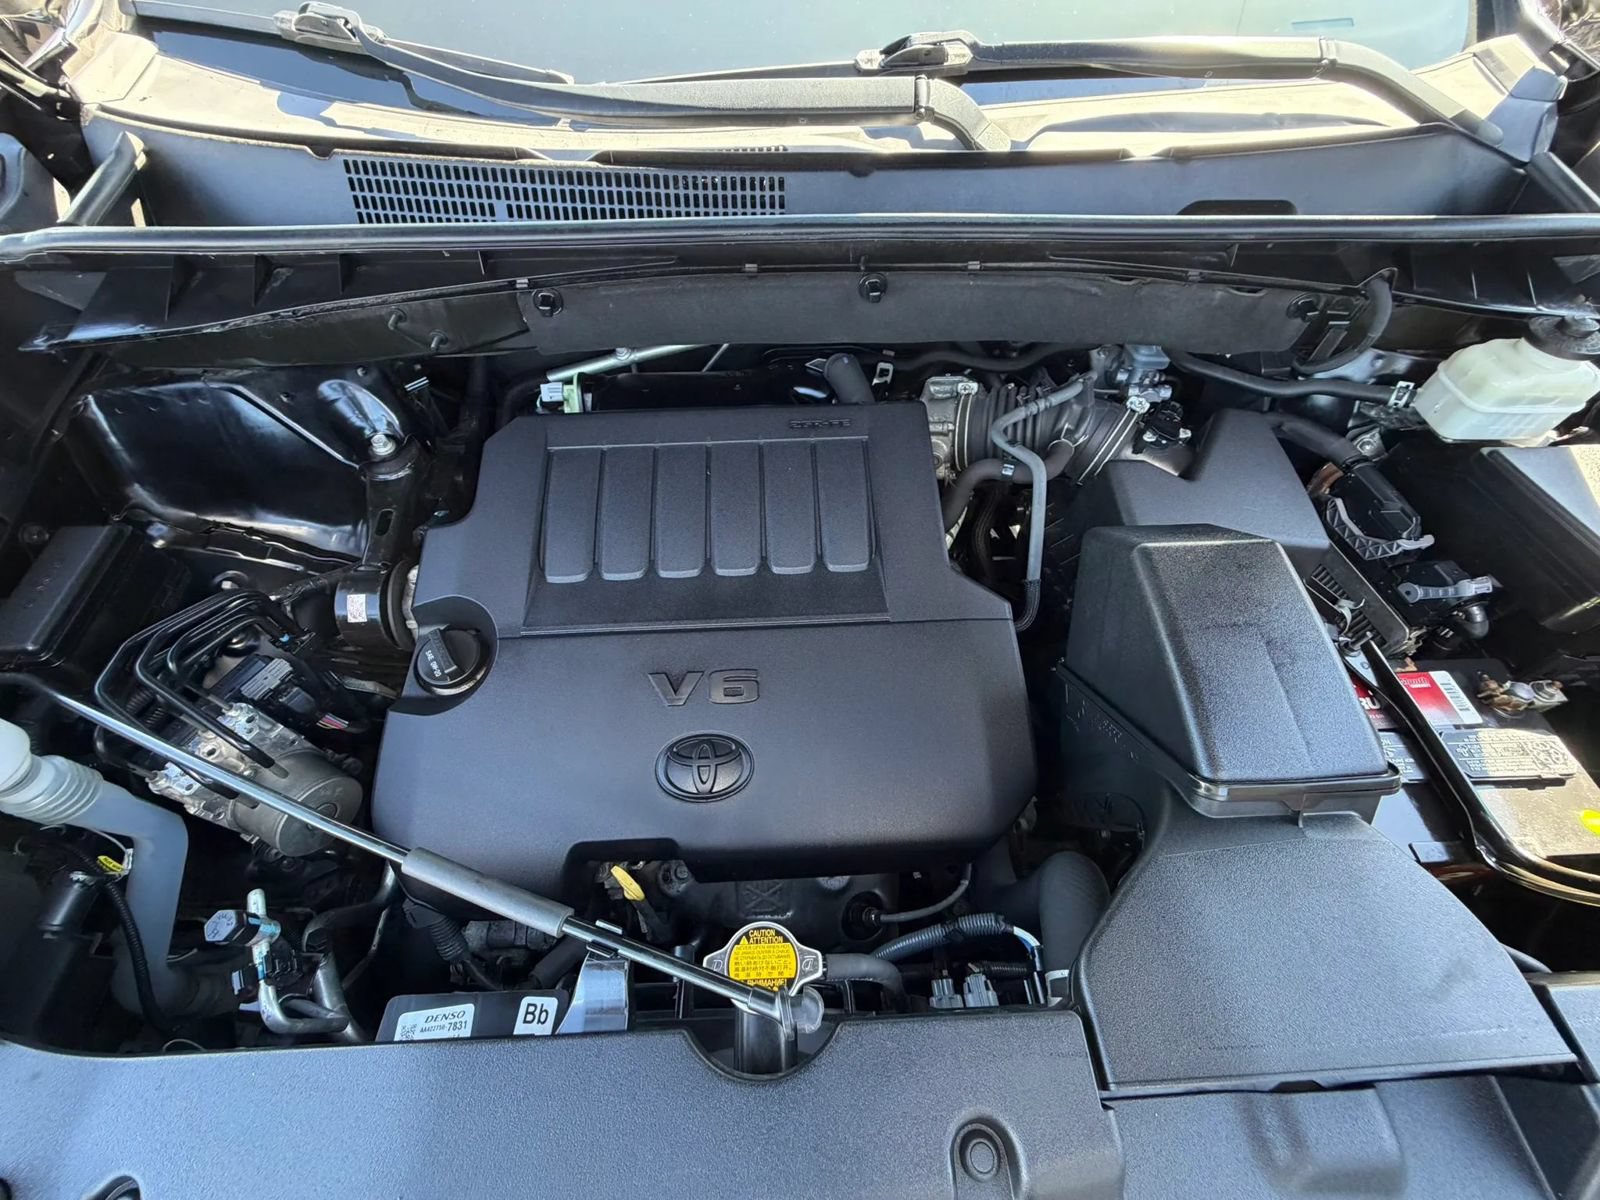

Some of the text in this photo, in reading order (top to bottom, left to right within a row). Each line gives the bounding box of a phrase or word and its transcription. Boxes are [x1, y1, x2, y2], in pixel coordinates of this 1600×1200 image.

[647, 668, 760, 707] V6
[748, 928, 776, 937] CAUTION
[749, 936, 784, 944] ATTENTION
[424, 1010, 466, 1024] DENSO
[522, 1003, 549, 1025] Bb
